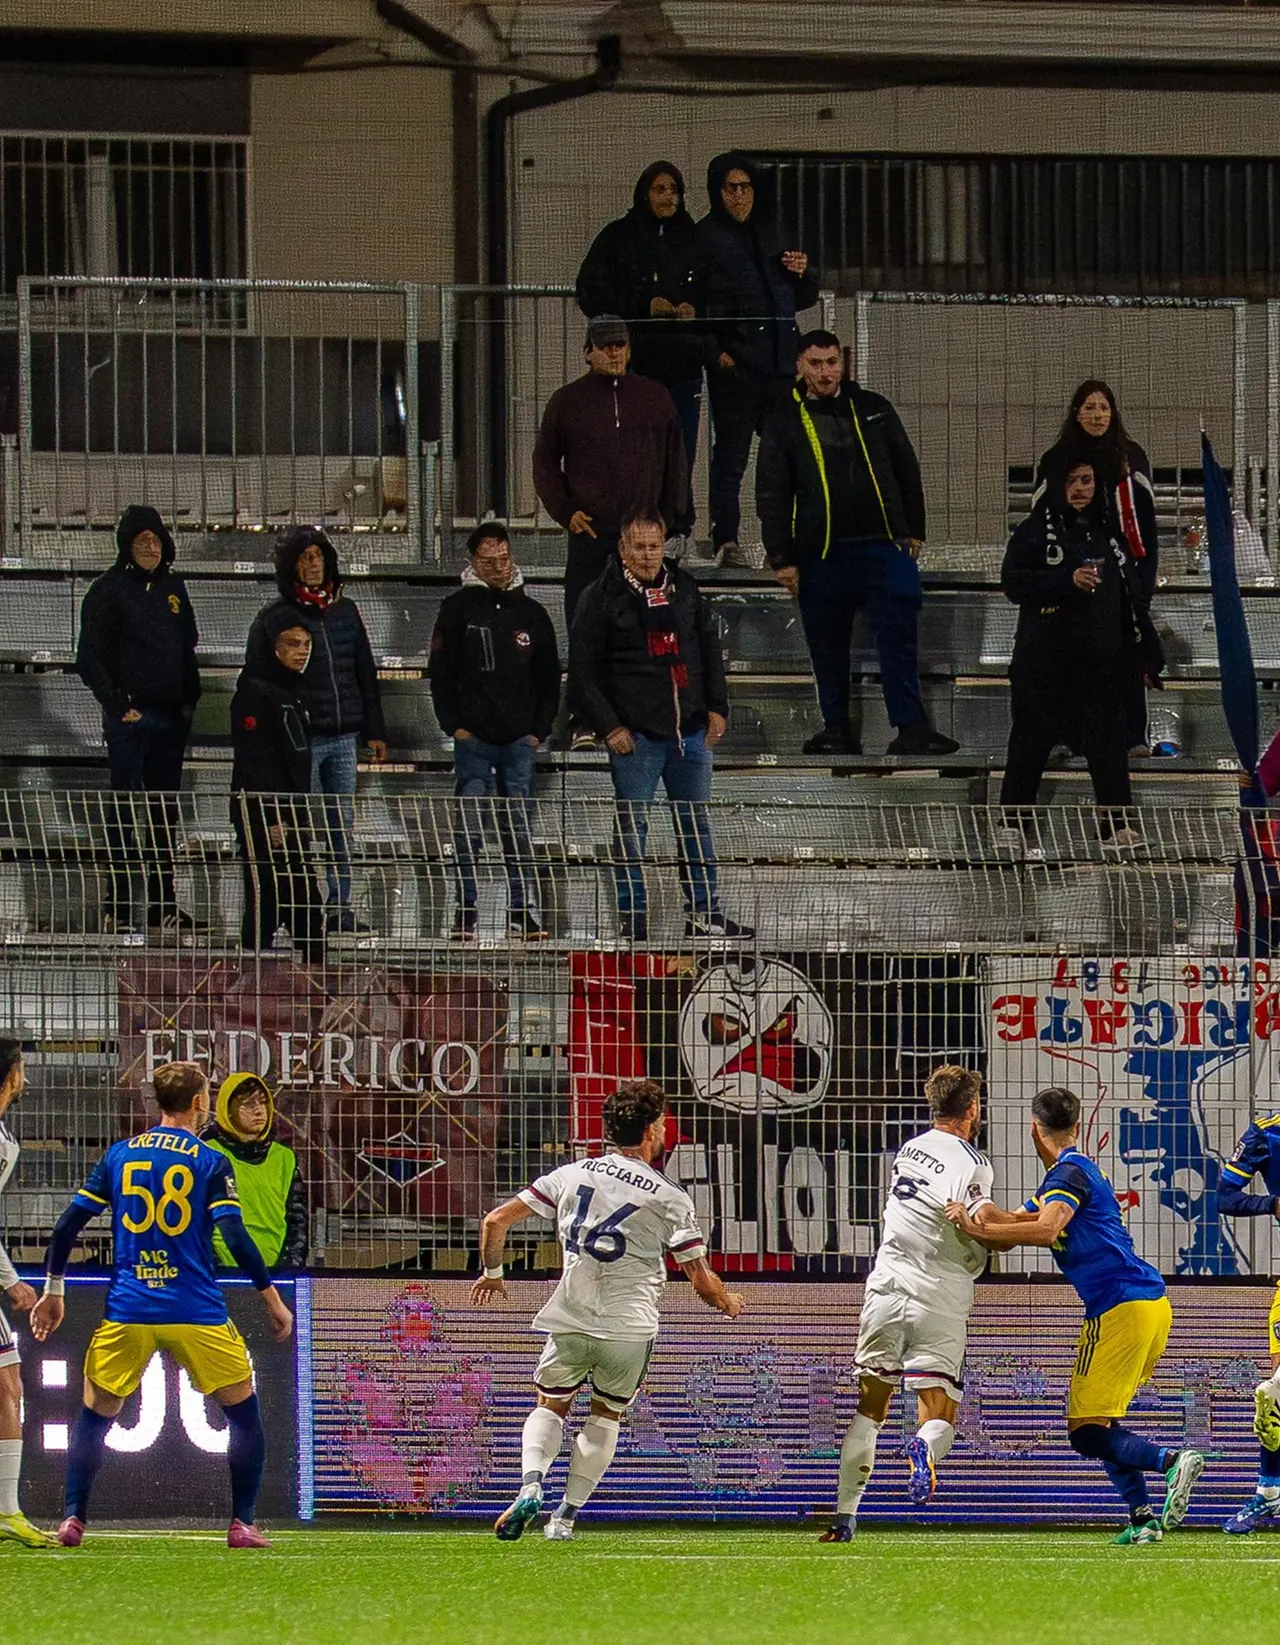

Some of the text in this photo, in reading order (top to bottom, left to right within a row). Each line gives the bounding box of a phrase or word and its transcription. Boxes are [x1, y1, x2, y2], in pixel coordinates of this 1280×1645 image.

[139, 1029, 480, 1095] FEDERICO
[128, 1132, 199, 1157] CRETELLA
[581, 1158, 662, 1195] RICCIARDI
[120, 1160, 195, 1237] 58
[565, 1184, 641, 1262] 16
[133, 1264, 179, 1280] Trade
[140, 1250, 168, 1265] MC
